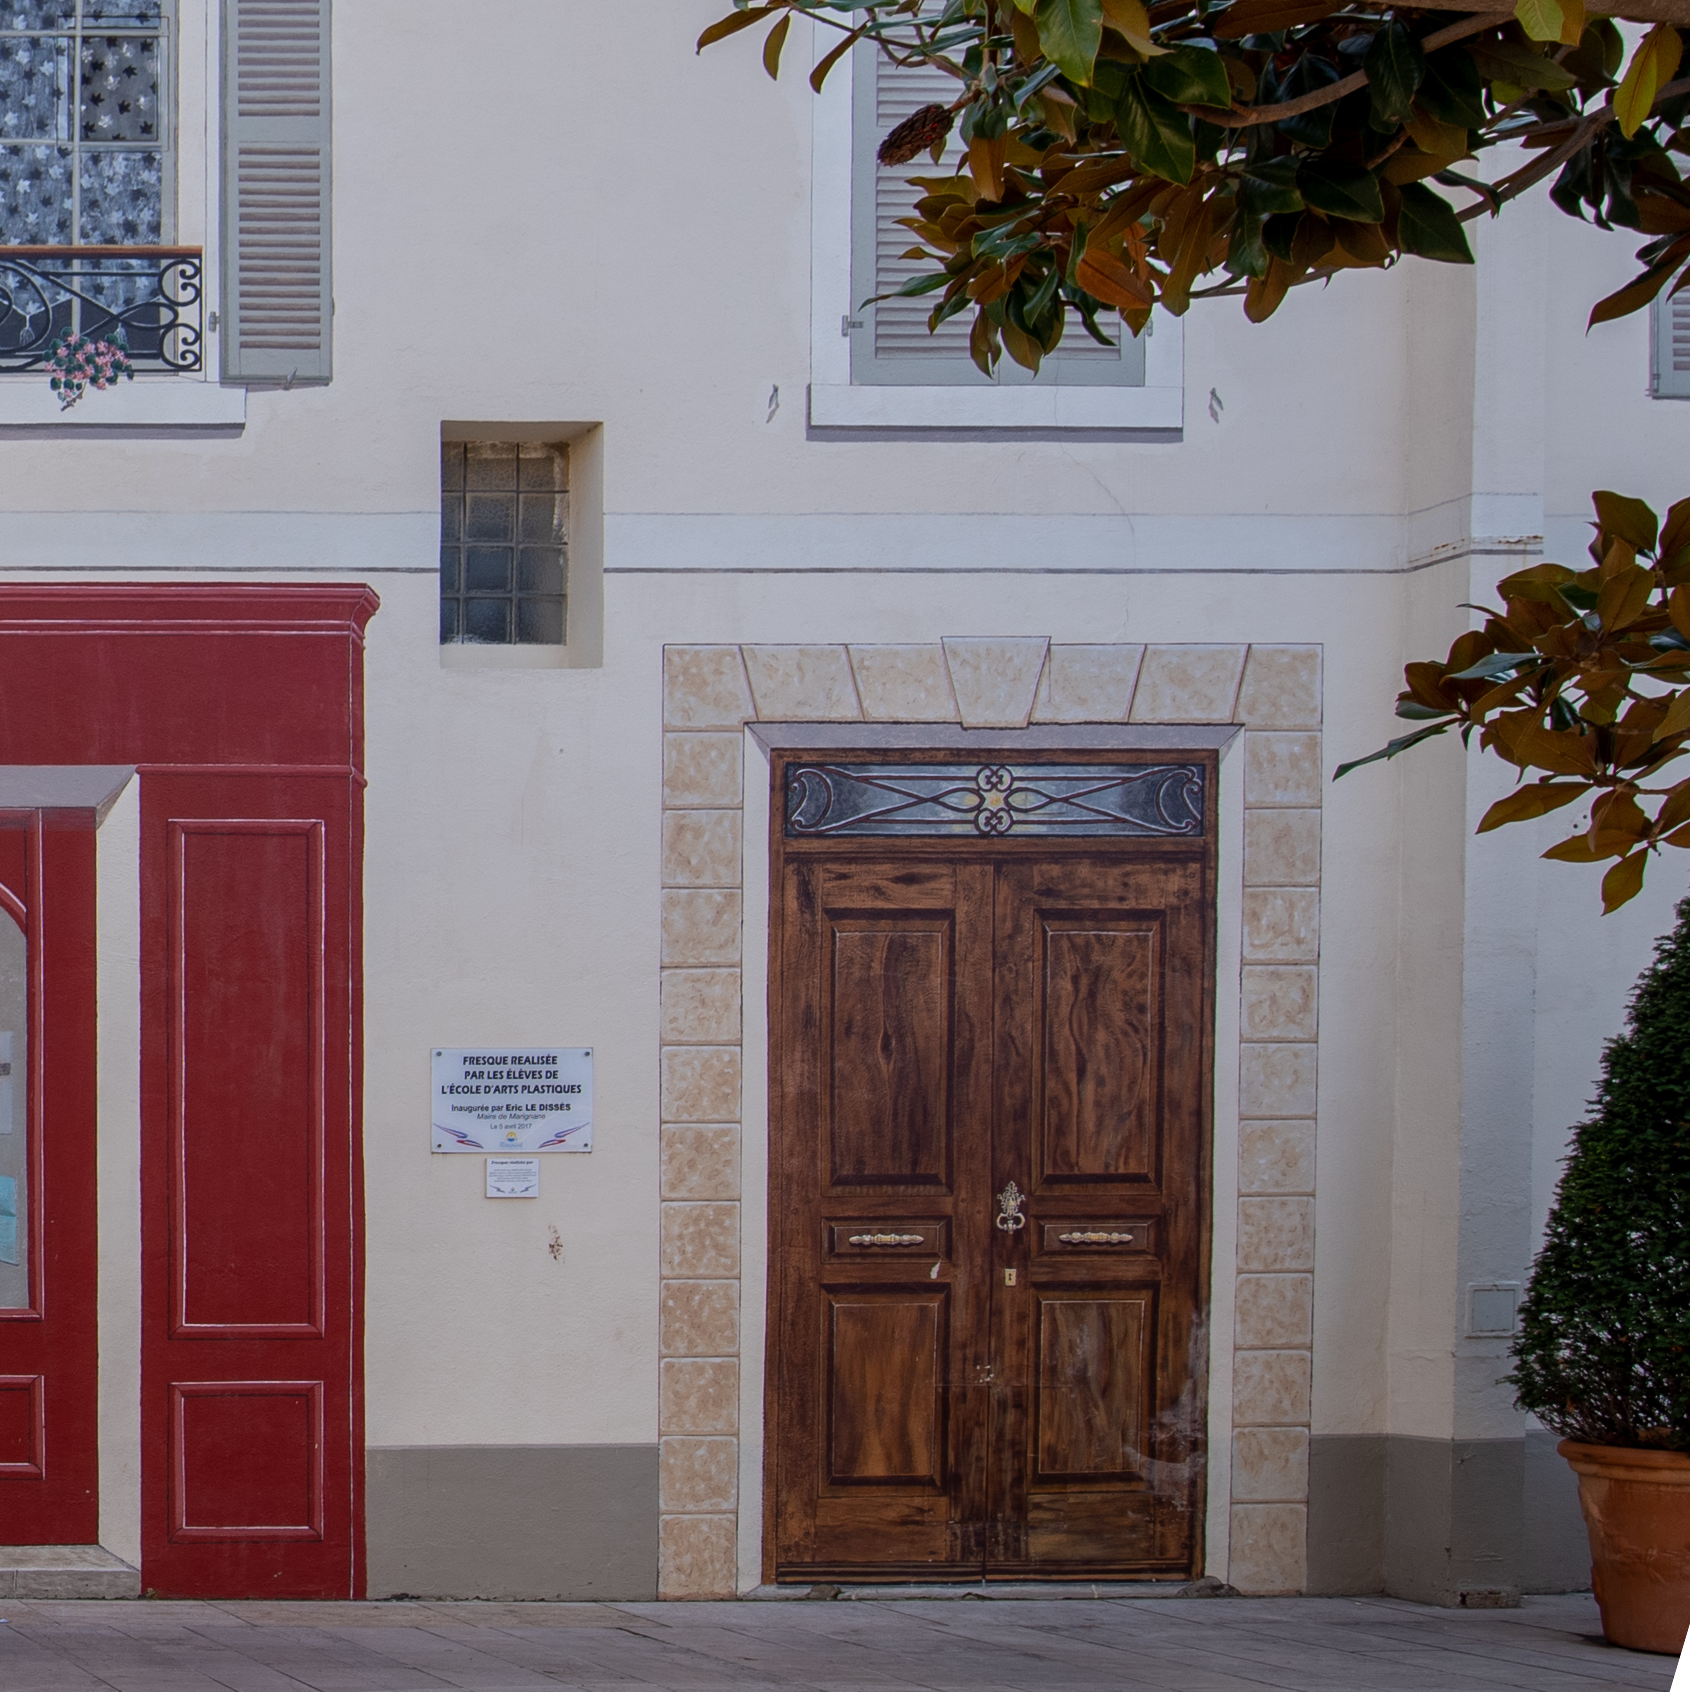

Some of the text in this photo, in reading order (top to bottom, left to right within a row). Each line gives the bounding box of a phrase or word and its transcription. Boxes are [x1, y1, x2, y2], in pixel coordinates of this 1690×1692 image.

[463, 1056, 508, 1065] FRESQUE
[464, 1070, 484, 1080] PAR
[487, 1070, 504, 1080] LES
[545, 1070, 559, 1080] DE
[441, 1083, 581, 1094] L'ÉCOLE D'ARTS PLASTIQUES
[451, 1104, 489, 1113] Inaugurée
[491, 1105, 504, 1113] par
[505, 1104, 523, 1112] Eric
[525, 1104, 537, 1112] LE
[509, 1113, 546, 1121] Marignane
